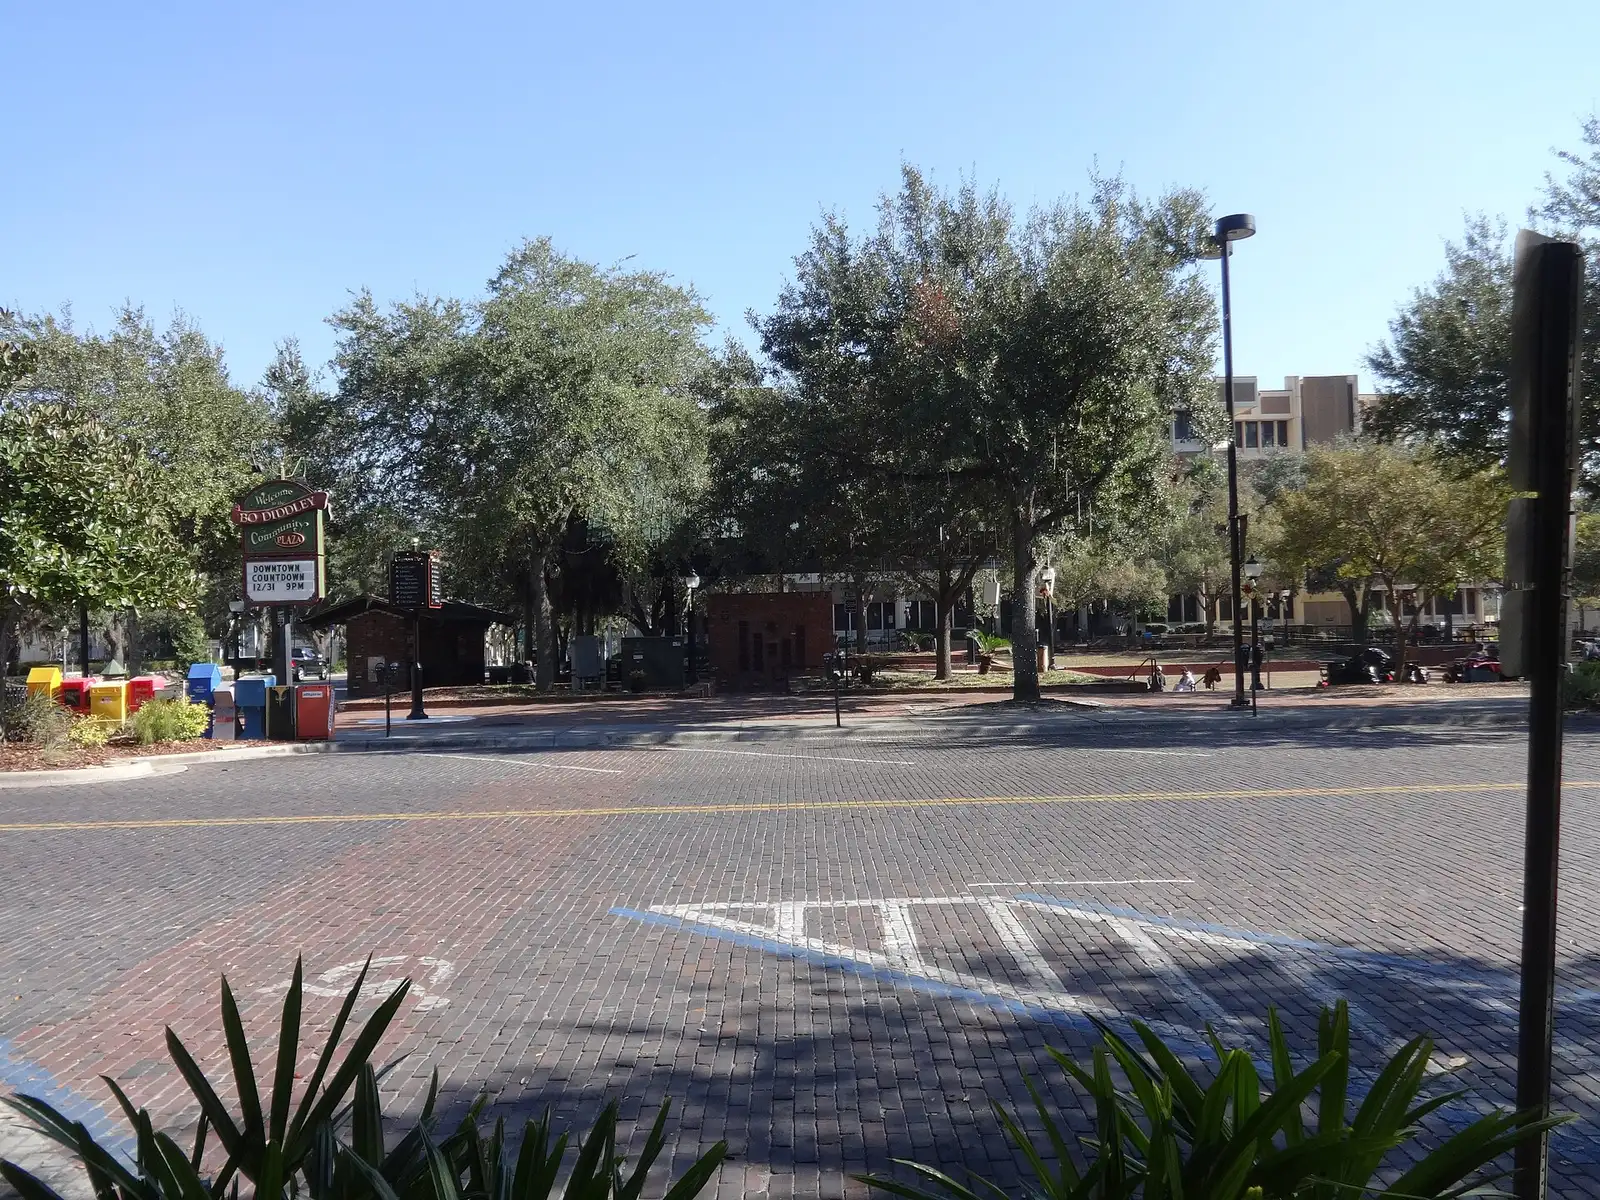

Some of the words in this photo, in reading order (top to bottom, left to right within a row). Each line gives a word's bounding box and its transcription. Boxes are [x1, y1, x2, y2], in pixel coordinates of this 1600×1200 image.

[255, 488, 293, 505] Welcome
[240, 512, 257, 523] BO
[261, 496, 316, 522] DIDDLEY
[250, 520, 310, 545] Community
[277, 534, 302, 545] PLAZA
[253, 564, 300, 573] DOWNTOWN
[251, 573, 305, 582] COUNTDOWN
[252, 583, 275, 591] 12/31
[285, 582, 305, 591] 9PM
